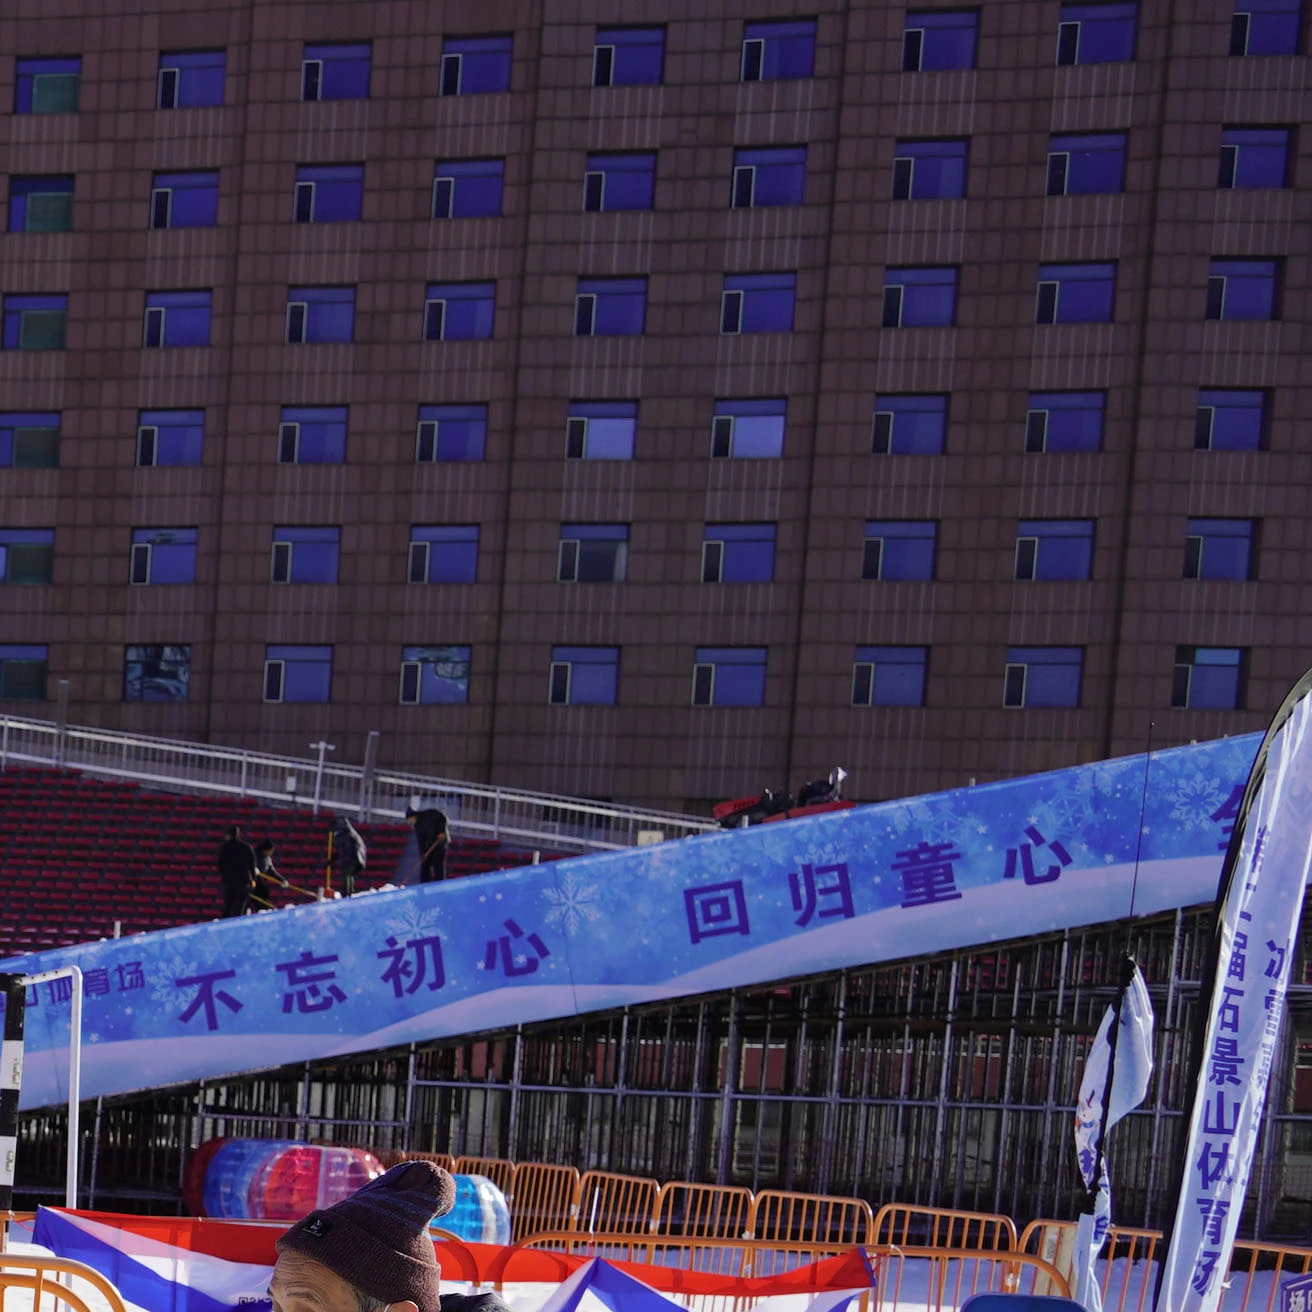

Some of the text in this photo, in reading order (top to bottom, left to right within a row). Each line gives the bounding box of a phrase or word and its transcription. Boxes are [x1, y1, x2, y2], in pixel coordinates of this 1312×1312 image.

[176, 825, 1073, 1031] 不忘初心 回归童心
